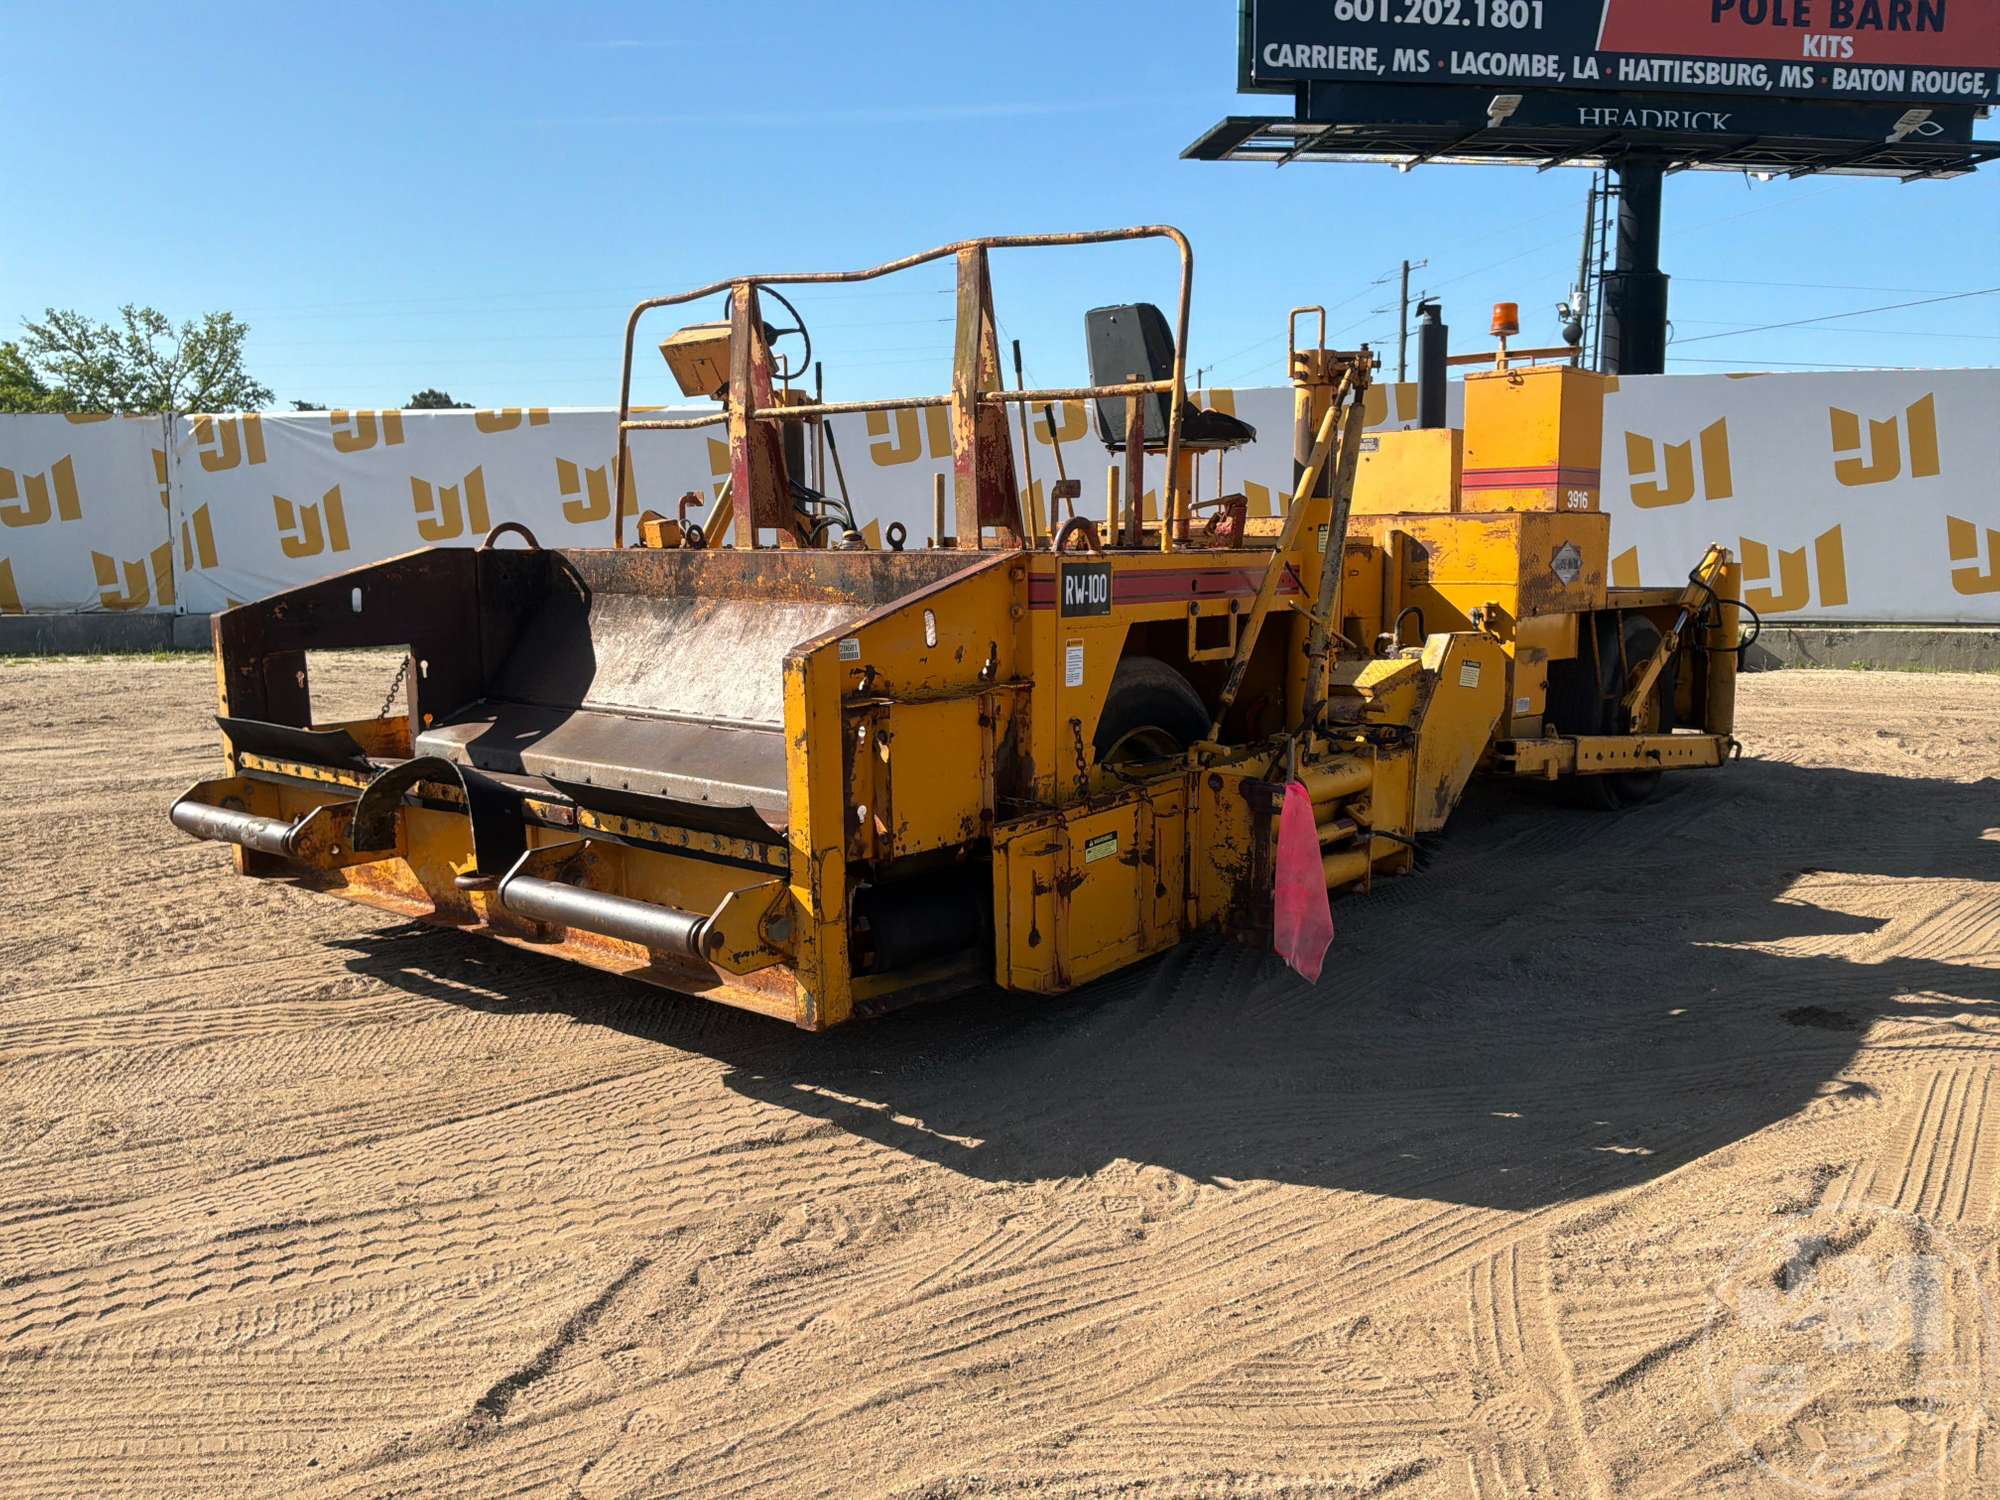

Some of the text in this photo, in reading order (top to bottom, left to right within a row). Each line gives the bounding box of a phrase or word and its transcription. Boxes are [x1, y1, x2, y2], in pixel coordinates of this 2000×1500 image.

[1334, 0, 1543, 29] 601.202.1801
[1711, 0, 1946, 32] POLE BARN
[1803, 34, 1854, 58] KITS
[1263, 43, 1386, 75] CARRIERE,
[1392, 49, 1430, 72] MS
[1450, 51, 1566, 82] LACOMBE,
[1573, 56, 1600, 79] LA
[1618, 59, 1773, 91] HATTIESBURG,
[1779, 66, 1814, 89] MS
[1832, 69, 1905, 92] BATON
[1911, 71, 1991, 98] ROUGE,
[1578, 107, 1734, 131] HEADRICK
[1567, 490, 1588, 509] 3916
[1066, 574, 1107, 605] RW-100
